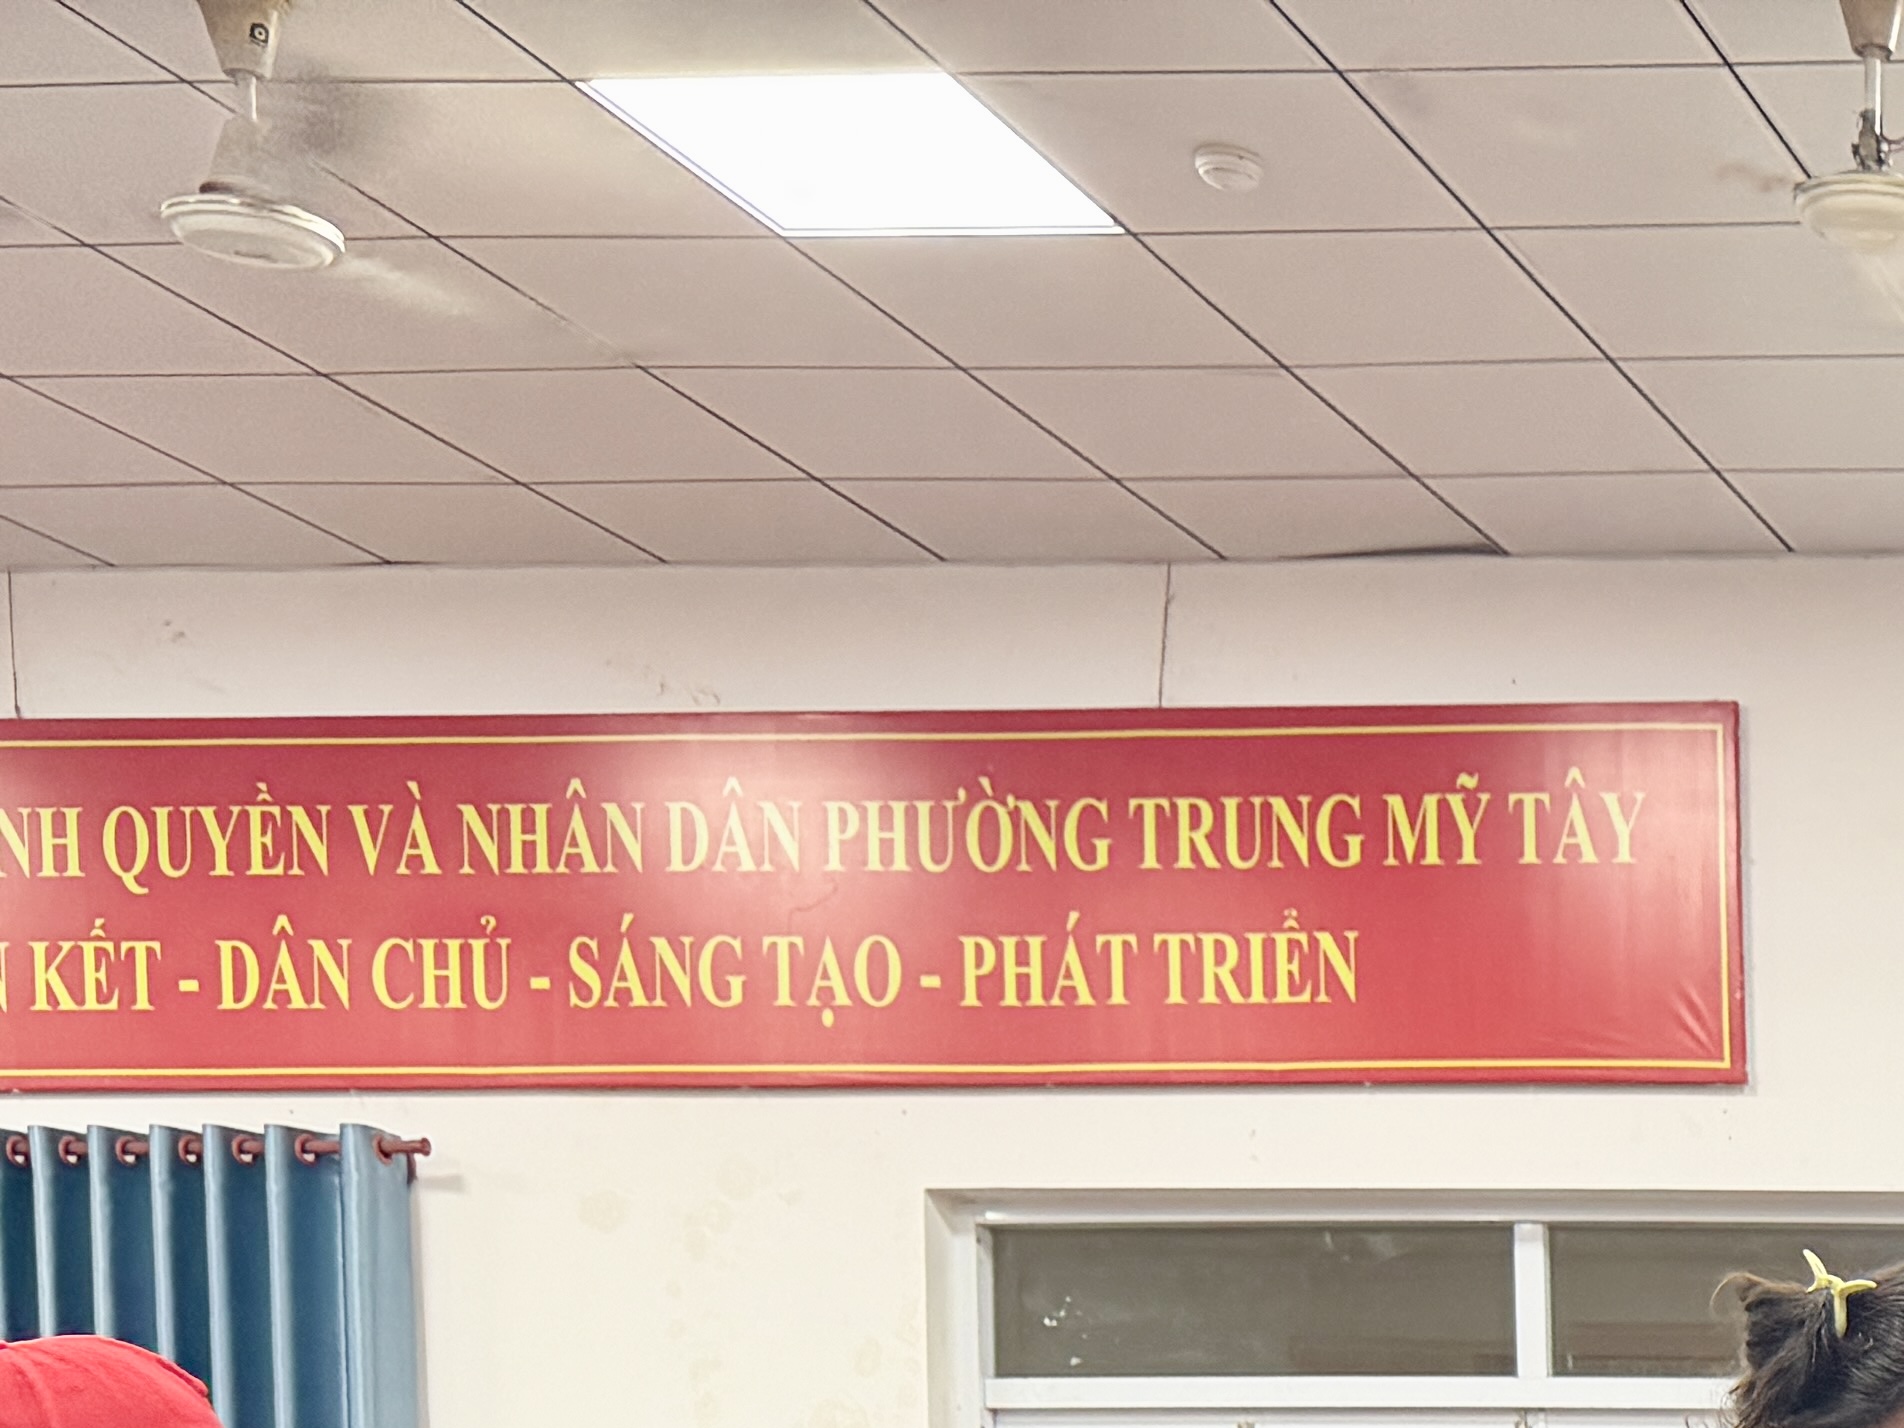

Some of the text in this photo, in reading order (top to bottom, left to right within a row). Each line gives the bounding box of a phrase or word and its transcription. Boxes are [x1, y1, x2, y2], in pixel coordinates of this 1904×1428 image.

[102, 781, 329, 895] QUYỀN
[347, 779, 442, 877] VÀ
[457, 777, 644, 875] NHÂN
[664, 775, 802, 873] DÂN
[822, 775, 1113, 874] PHƯỜNG
[1128, 793, 1365, 871] TRUNG
[1383, 771, 1491, 866] MỸ
[1508, 766, 1647, 866] TÂY
[28, 917, 162, 1012] KẾT
[215, 914, 352, 1011] DÂN
[372, 914, 511, 1010] CHỦ
[567, 913, 747, 1010] SÁNG
[762, 934, 901, 1028] TẠO
[958, 911, 1139, 1008] PHÁT
[1153, 907, 1359, 1005] TRIỂN
